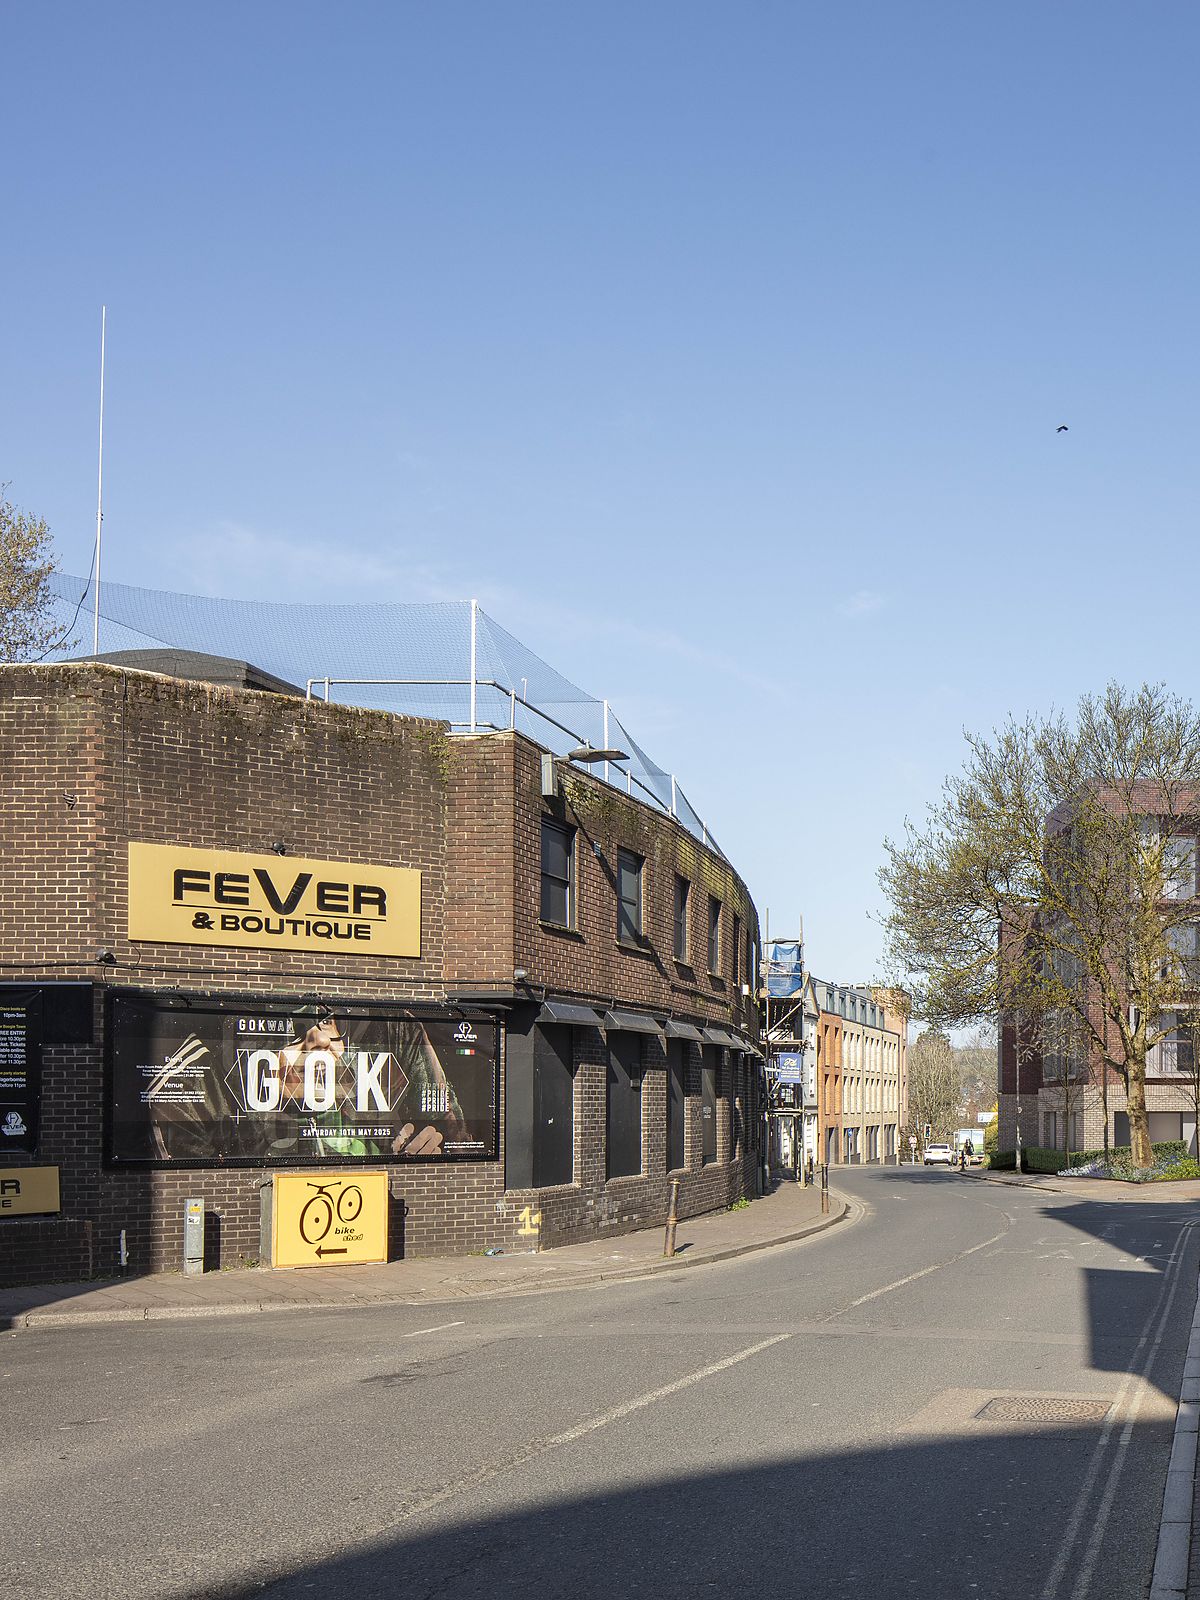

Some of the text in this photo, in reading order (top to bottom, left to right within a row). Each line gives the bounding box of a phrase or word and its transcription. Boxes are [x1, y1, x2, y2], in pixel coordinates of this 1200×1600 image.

[173, 868, 387, 916] FEVER
[191, 911, 371, 940] & BOUTIQUE
[246, 1050, 391, 1112] GOK
[421, 1104, 450, 1112] #PRIDE
[302, 1128, 391, 1136] SATURDAY 10TH MAY 2025
[334, 1227, 355, 1235] bike
